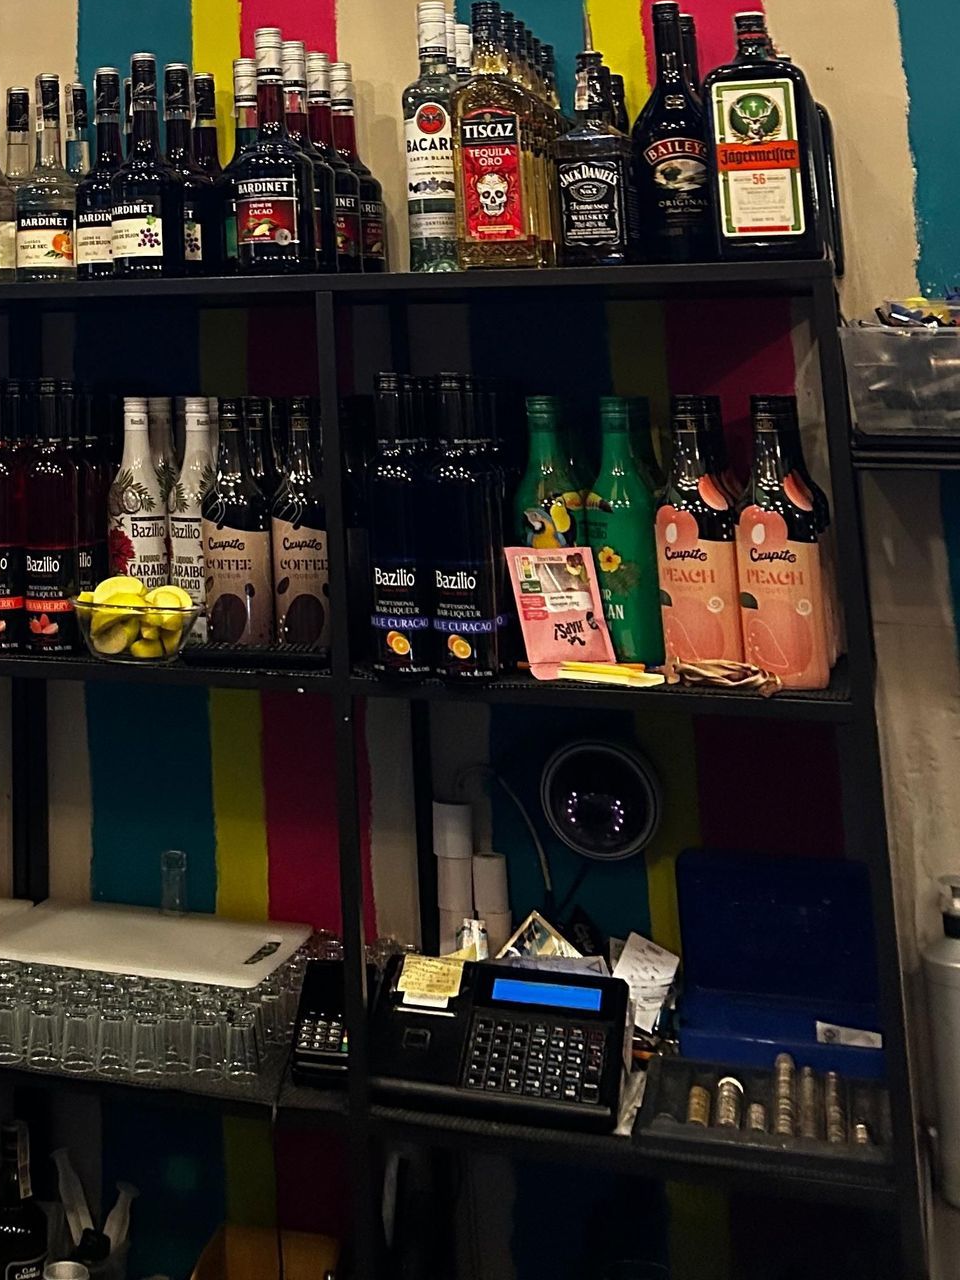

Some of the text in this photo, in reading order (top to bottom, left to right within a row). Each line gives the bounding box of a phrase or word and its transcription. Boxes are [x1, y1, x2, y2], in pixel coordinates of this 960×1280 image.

[463, 123, 514, 139] TISCAZ
[406, 137, 453, 153] BACAR
[468, 148, 511, 157] TEQUILA
[479, 157, 503, 166] ORO
[560, 164, 619, 188] JACK DANIEL'S
[752, 173, 766, 185] 56
[238, 182, 288, 194] BARDINET
[21, 217, 68, 227] BARDINET
[131, 523, 165, 538] Bazilio
[171, 522, 201, 539] Bazilio
[26, 555, 60, 572] Bazilio
[205, 559, 252, 570] COFFEE
[374, 567, 415, 587] Bazilio
[435, 570, 476, 590] Bazilio
[745, 569, 804, 586] PEACH
[448, 622, 492, 631] CURACAO
